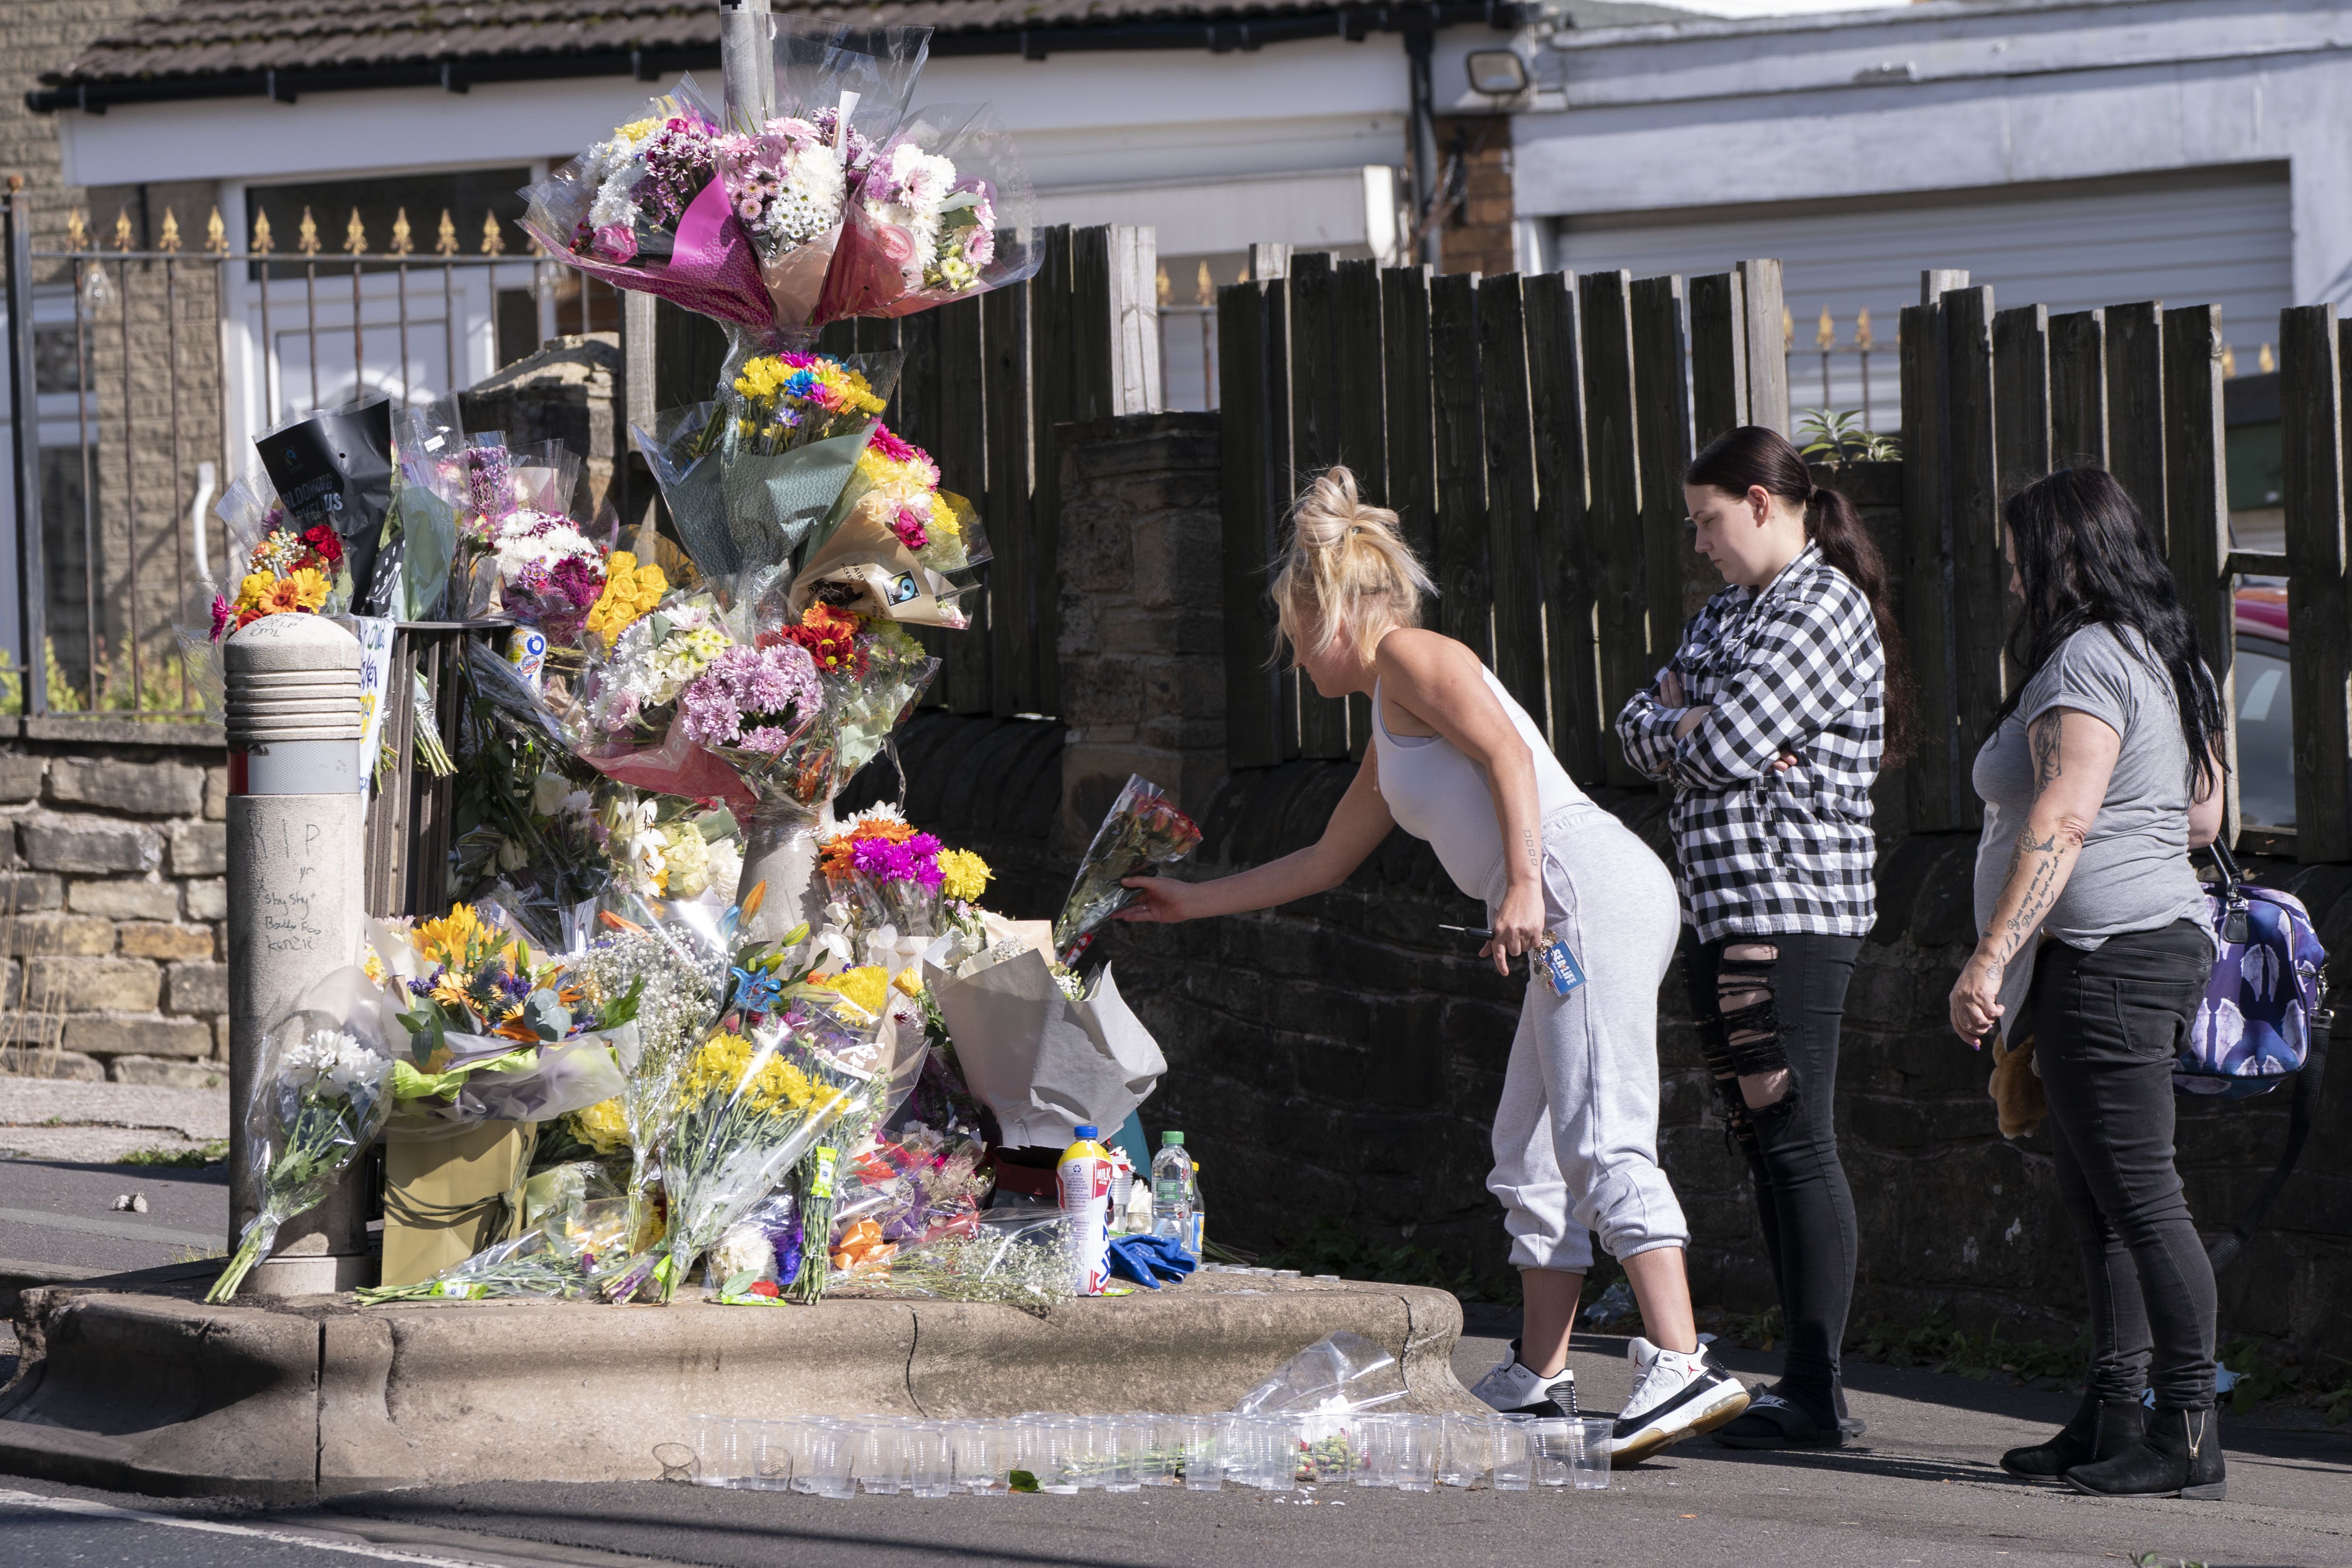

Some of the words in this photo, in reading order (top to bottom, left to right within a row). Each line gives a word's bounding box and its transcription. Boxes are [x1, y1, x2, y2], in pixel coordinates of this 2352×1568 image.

[840, 563, 854, 582] PICKED
[2007, 908, 2023, 931] Your
[2021, 891, 2033, 909] wings
[2030, 876, 2040, 891] were
[2022, 908, 2036, 928] But
[2035, 900, 2043, 910] my
[2039, 881, 2050, 899] heart
[1554, 948, 1567, 969] SEA
[1754, 1395, 1788, 1406] NIKE
